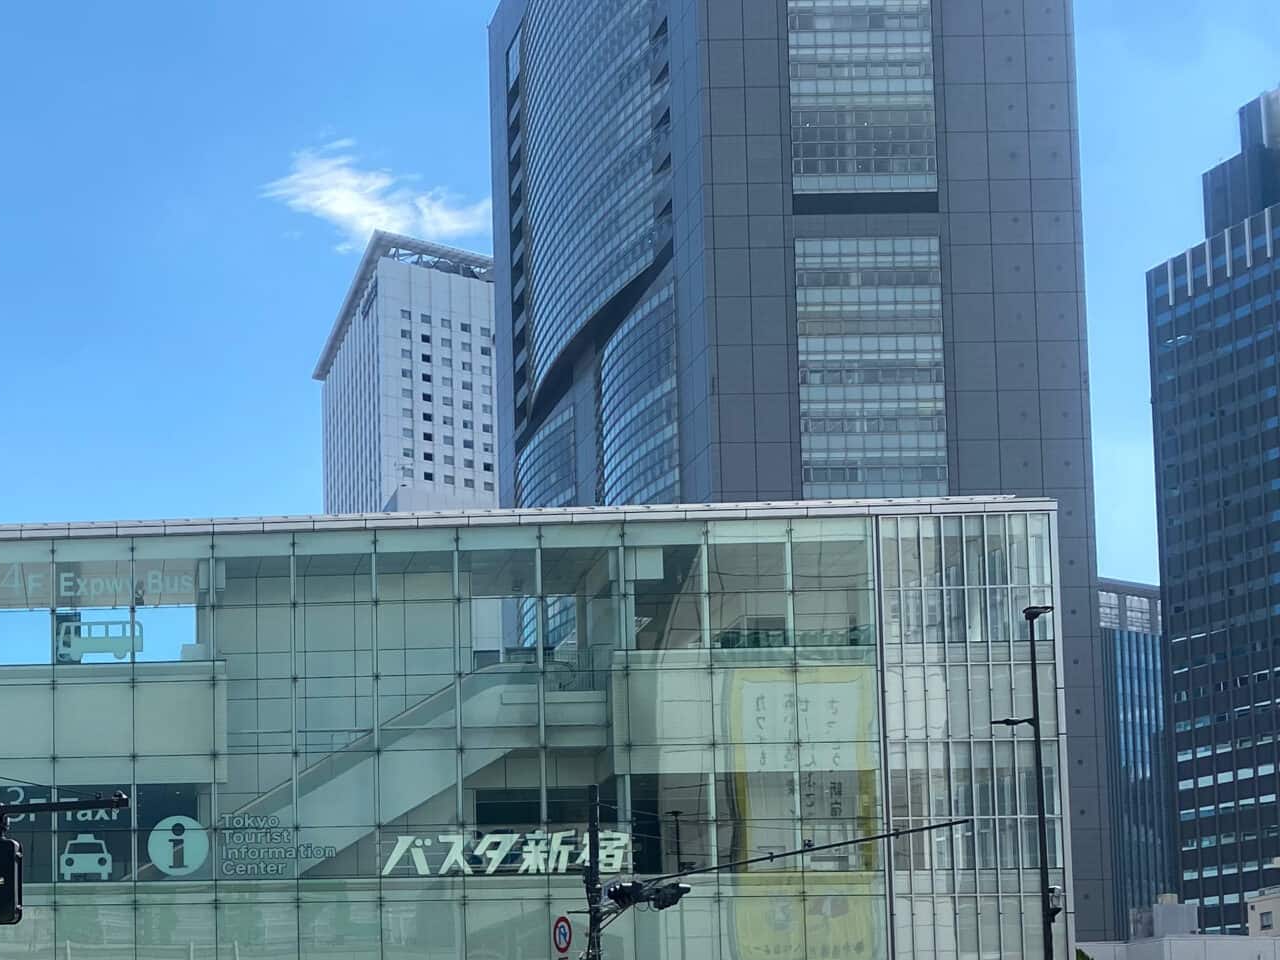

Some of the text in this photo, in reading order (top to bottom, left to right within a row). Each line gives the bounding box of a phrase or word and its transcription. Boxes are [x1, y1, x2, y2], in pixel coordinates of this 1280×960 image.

[59, 572, 139, 600] Expwy
[147, 570, 195, 595] Bus
[222, 813, 280, 829] Tokyo
[222, 829, 290, 844] Tourist
[222, 844, 337, 859] Information
[381, 830, 630, 875] バスタ新宿
[222, 860, 287, 876] Center
